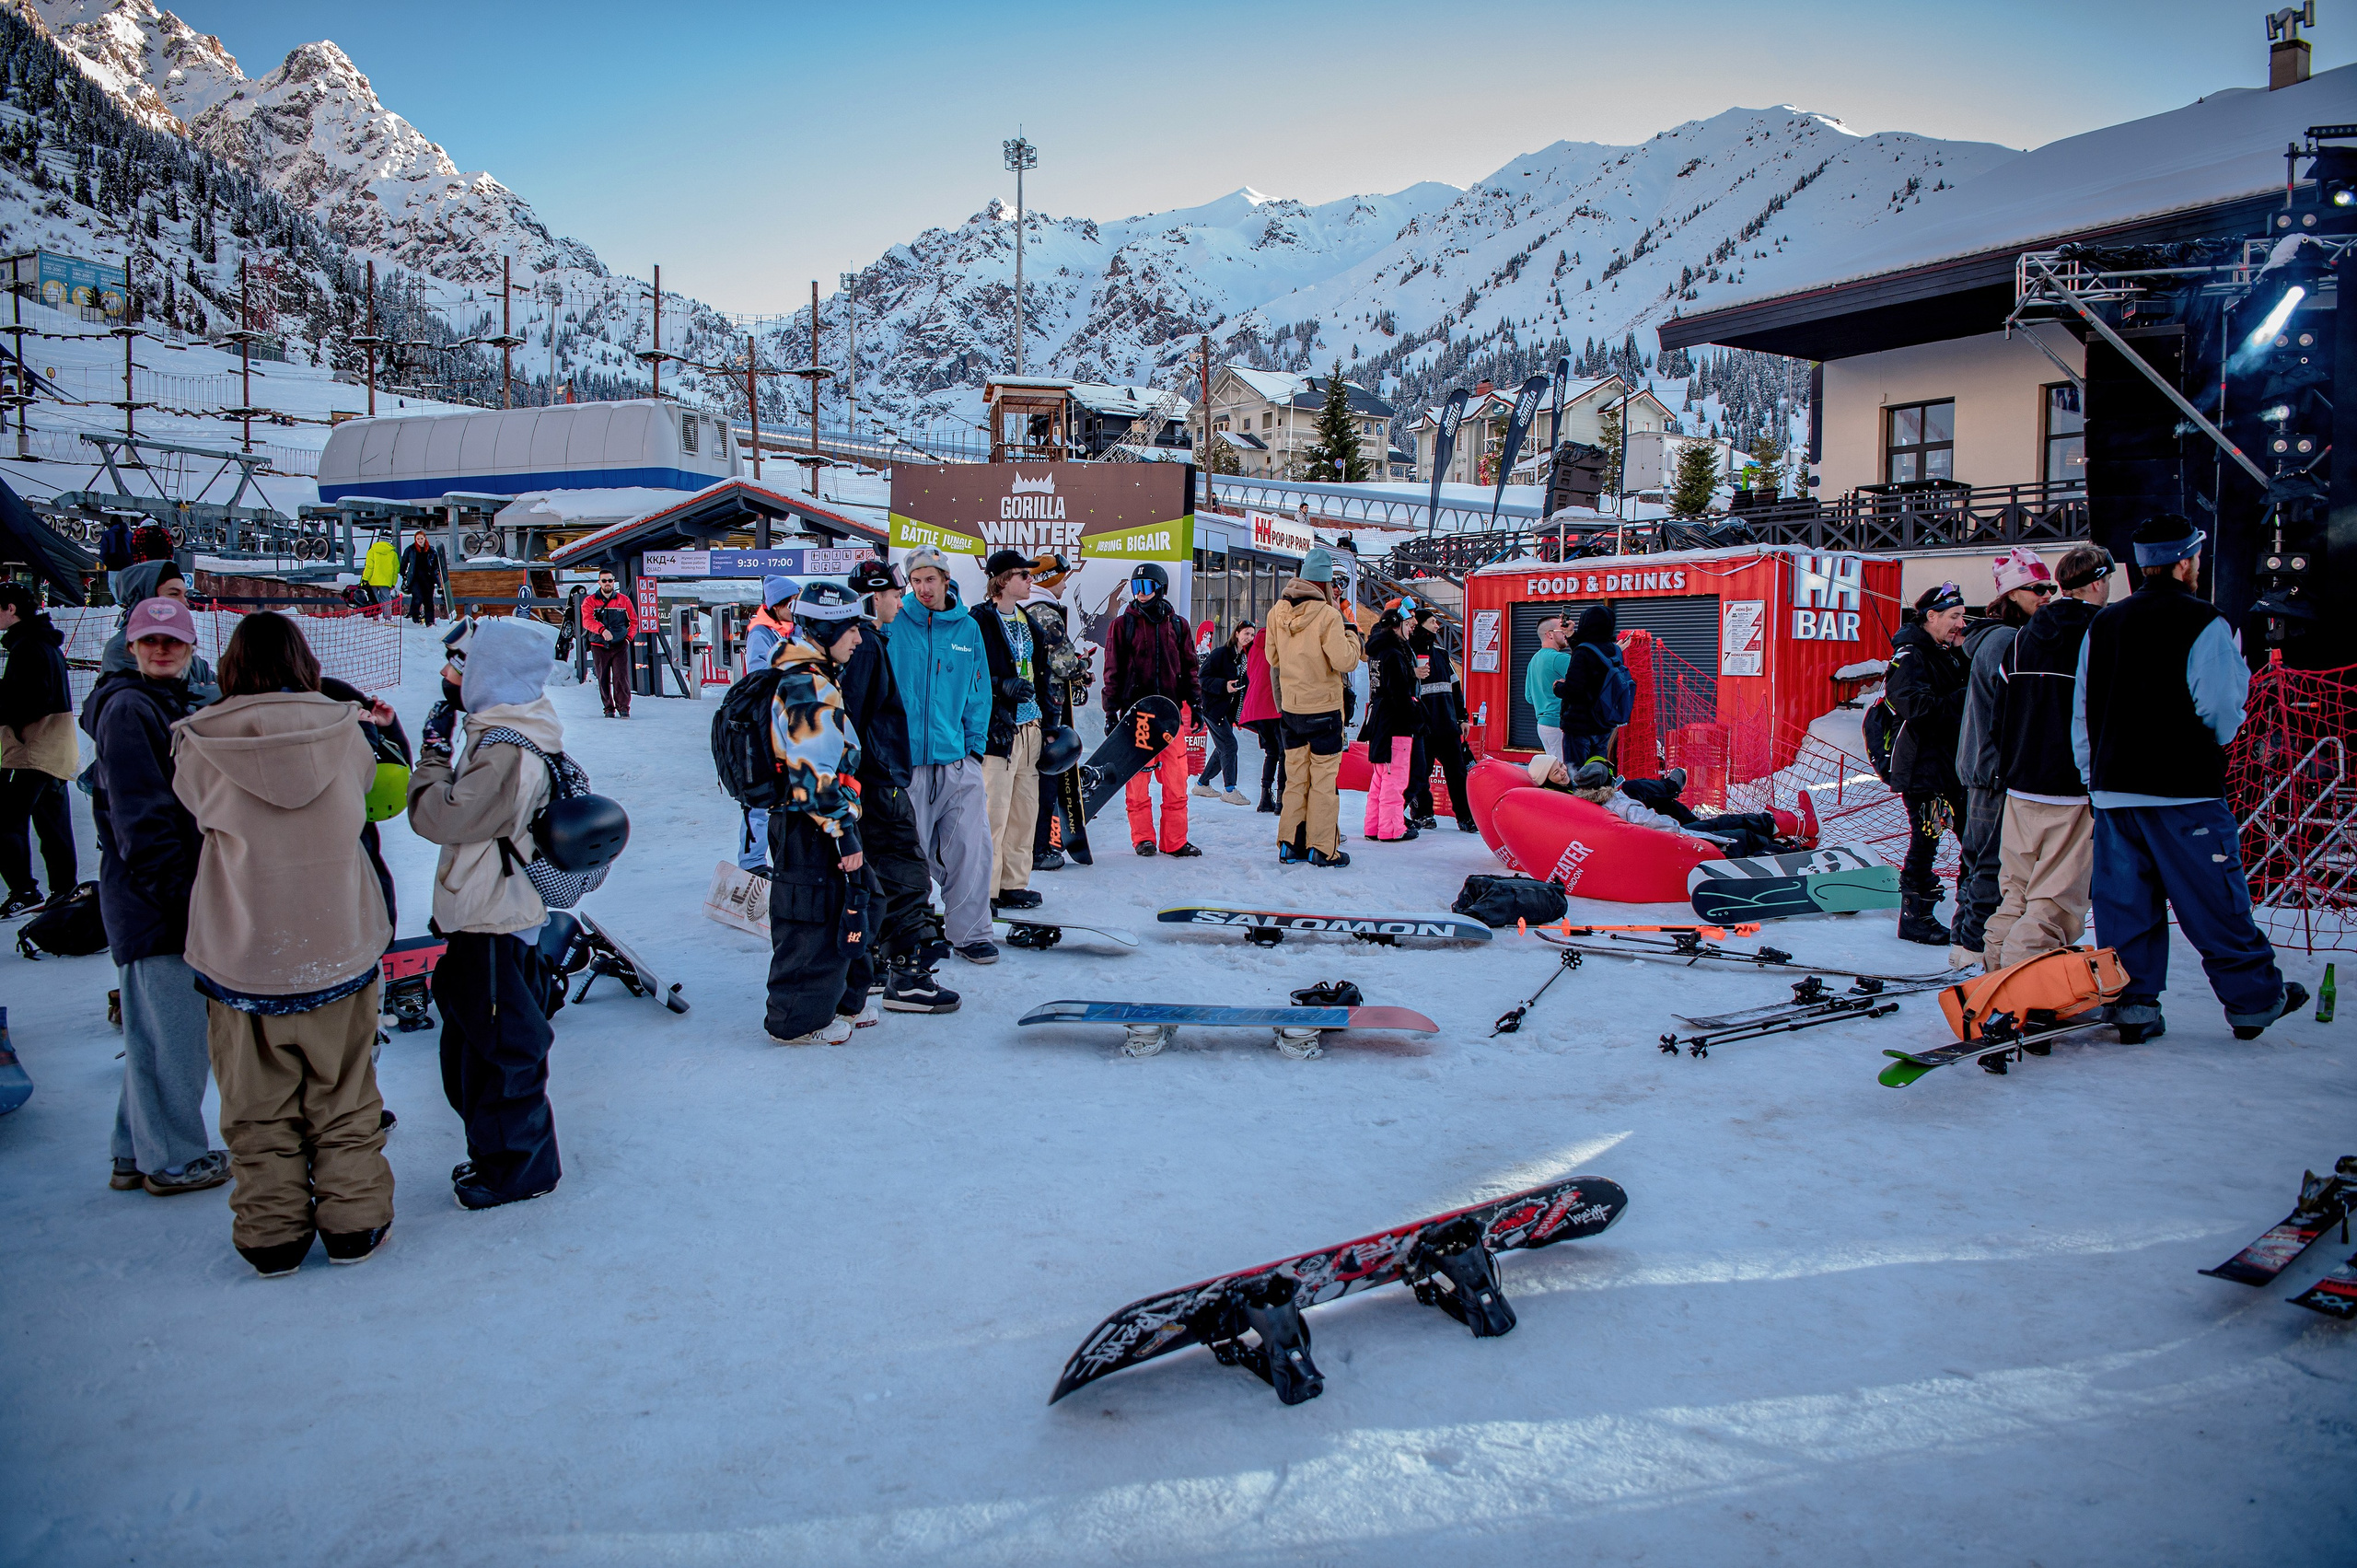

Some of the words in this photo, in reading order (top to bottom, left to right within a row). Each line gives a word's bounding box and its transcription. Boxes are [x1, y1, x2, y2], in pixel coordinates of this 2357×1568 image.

[1445, 401, 1461, 438] GORILLA
[1518, 389, 1538, 428] GORILLA
[1000, 496, 1066, 519] GORILLA
[900, 524, 939, 545] BATTLE
[942, 534, 972, 549] JUNGLE
[977, 521, 1086, 545] WINTER
[1096, 538, 1122, 552] JIBBING
[1126, 531, 1171, 552] BIGAIR
[1255, 517, 1271, 544] HH
[1295, 536, 1310, 552] PARK
[646, 555, 677, 565] ККД-4
[737, 558, 760, 568] 9:30
[767, 558, 794, 567] 17:00
[1527, 576, 1579, 596] FOOD
[1585, 575, 1600, 592] &
[1606, 571, 1686, 593] DRINKS
[1794, 554, 1862, 611] HH
[819, 597, 843, 606] GORILLA
[1792, 610, 1861, 641] BAR
[1134, 711, 1155, 750] head
[1066, 797, 1076, 834] PLANK
[1565, 867, 1585, 893] LONDON
[1191, 910, 1457, 937] SALOMON
